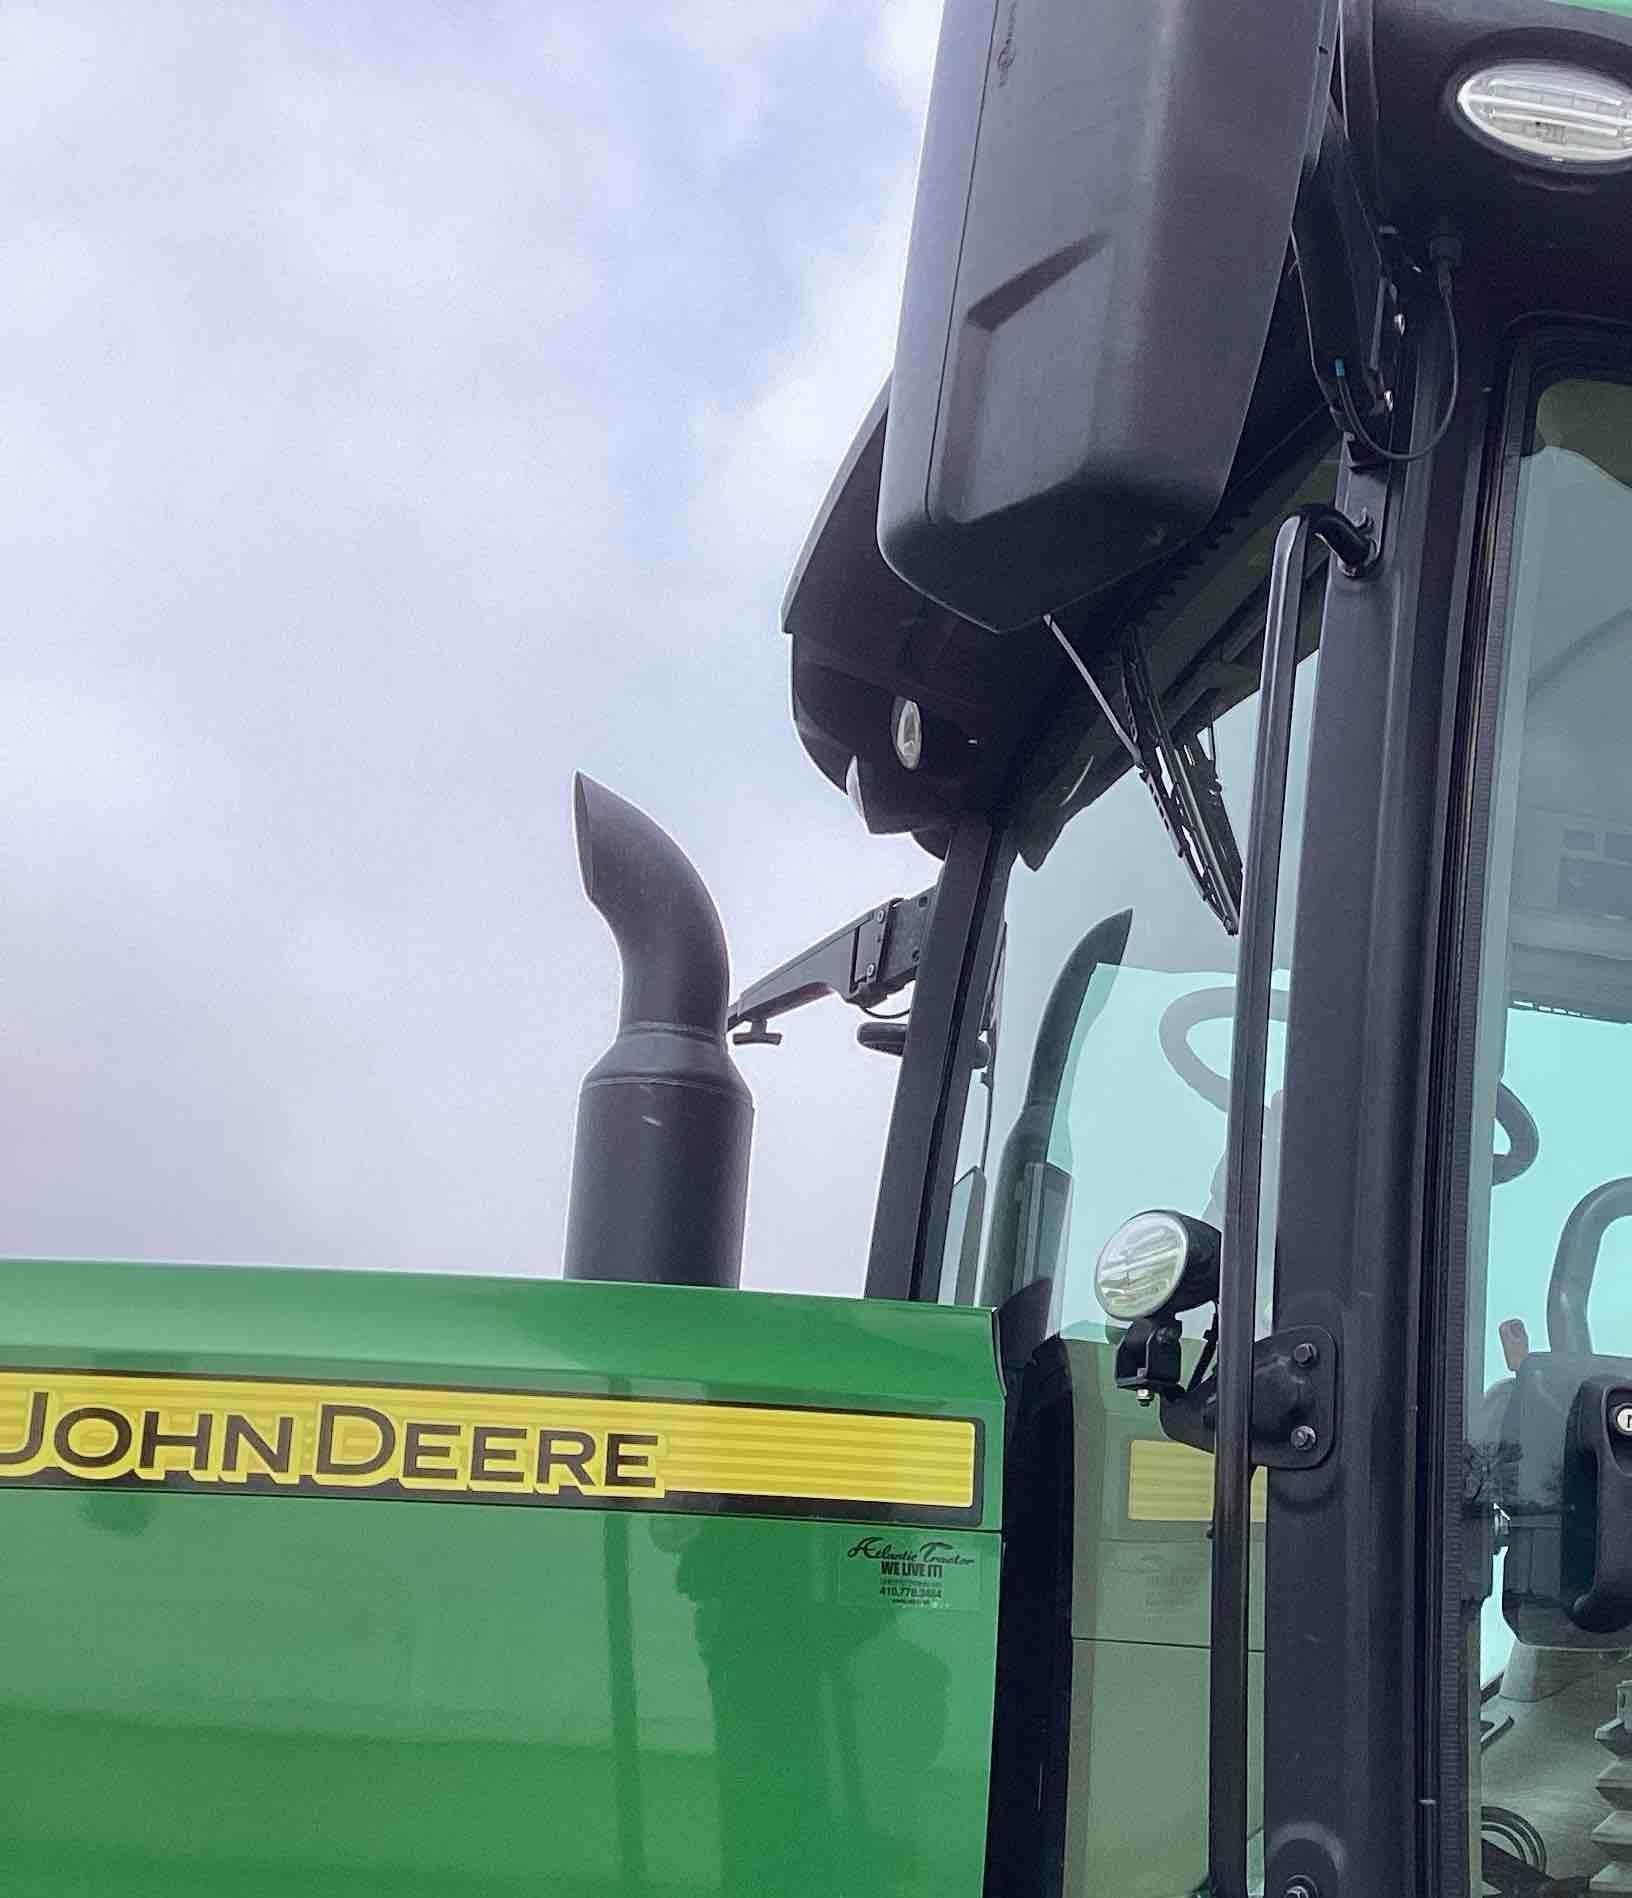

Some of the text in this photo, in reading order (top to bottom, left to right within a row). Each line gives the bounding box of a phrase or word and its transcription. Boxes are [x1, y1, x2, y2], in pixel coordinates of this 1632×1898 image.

[0, 1391, 659, 1489] JOHN DEERE
[847, 1536, 976, 1565] Atlantic Tractor
[881, 1560, 899, 1576] WE
[902, 1562, 926, 1577] LIVE
